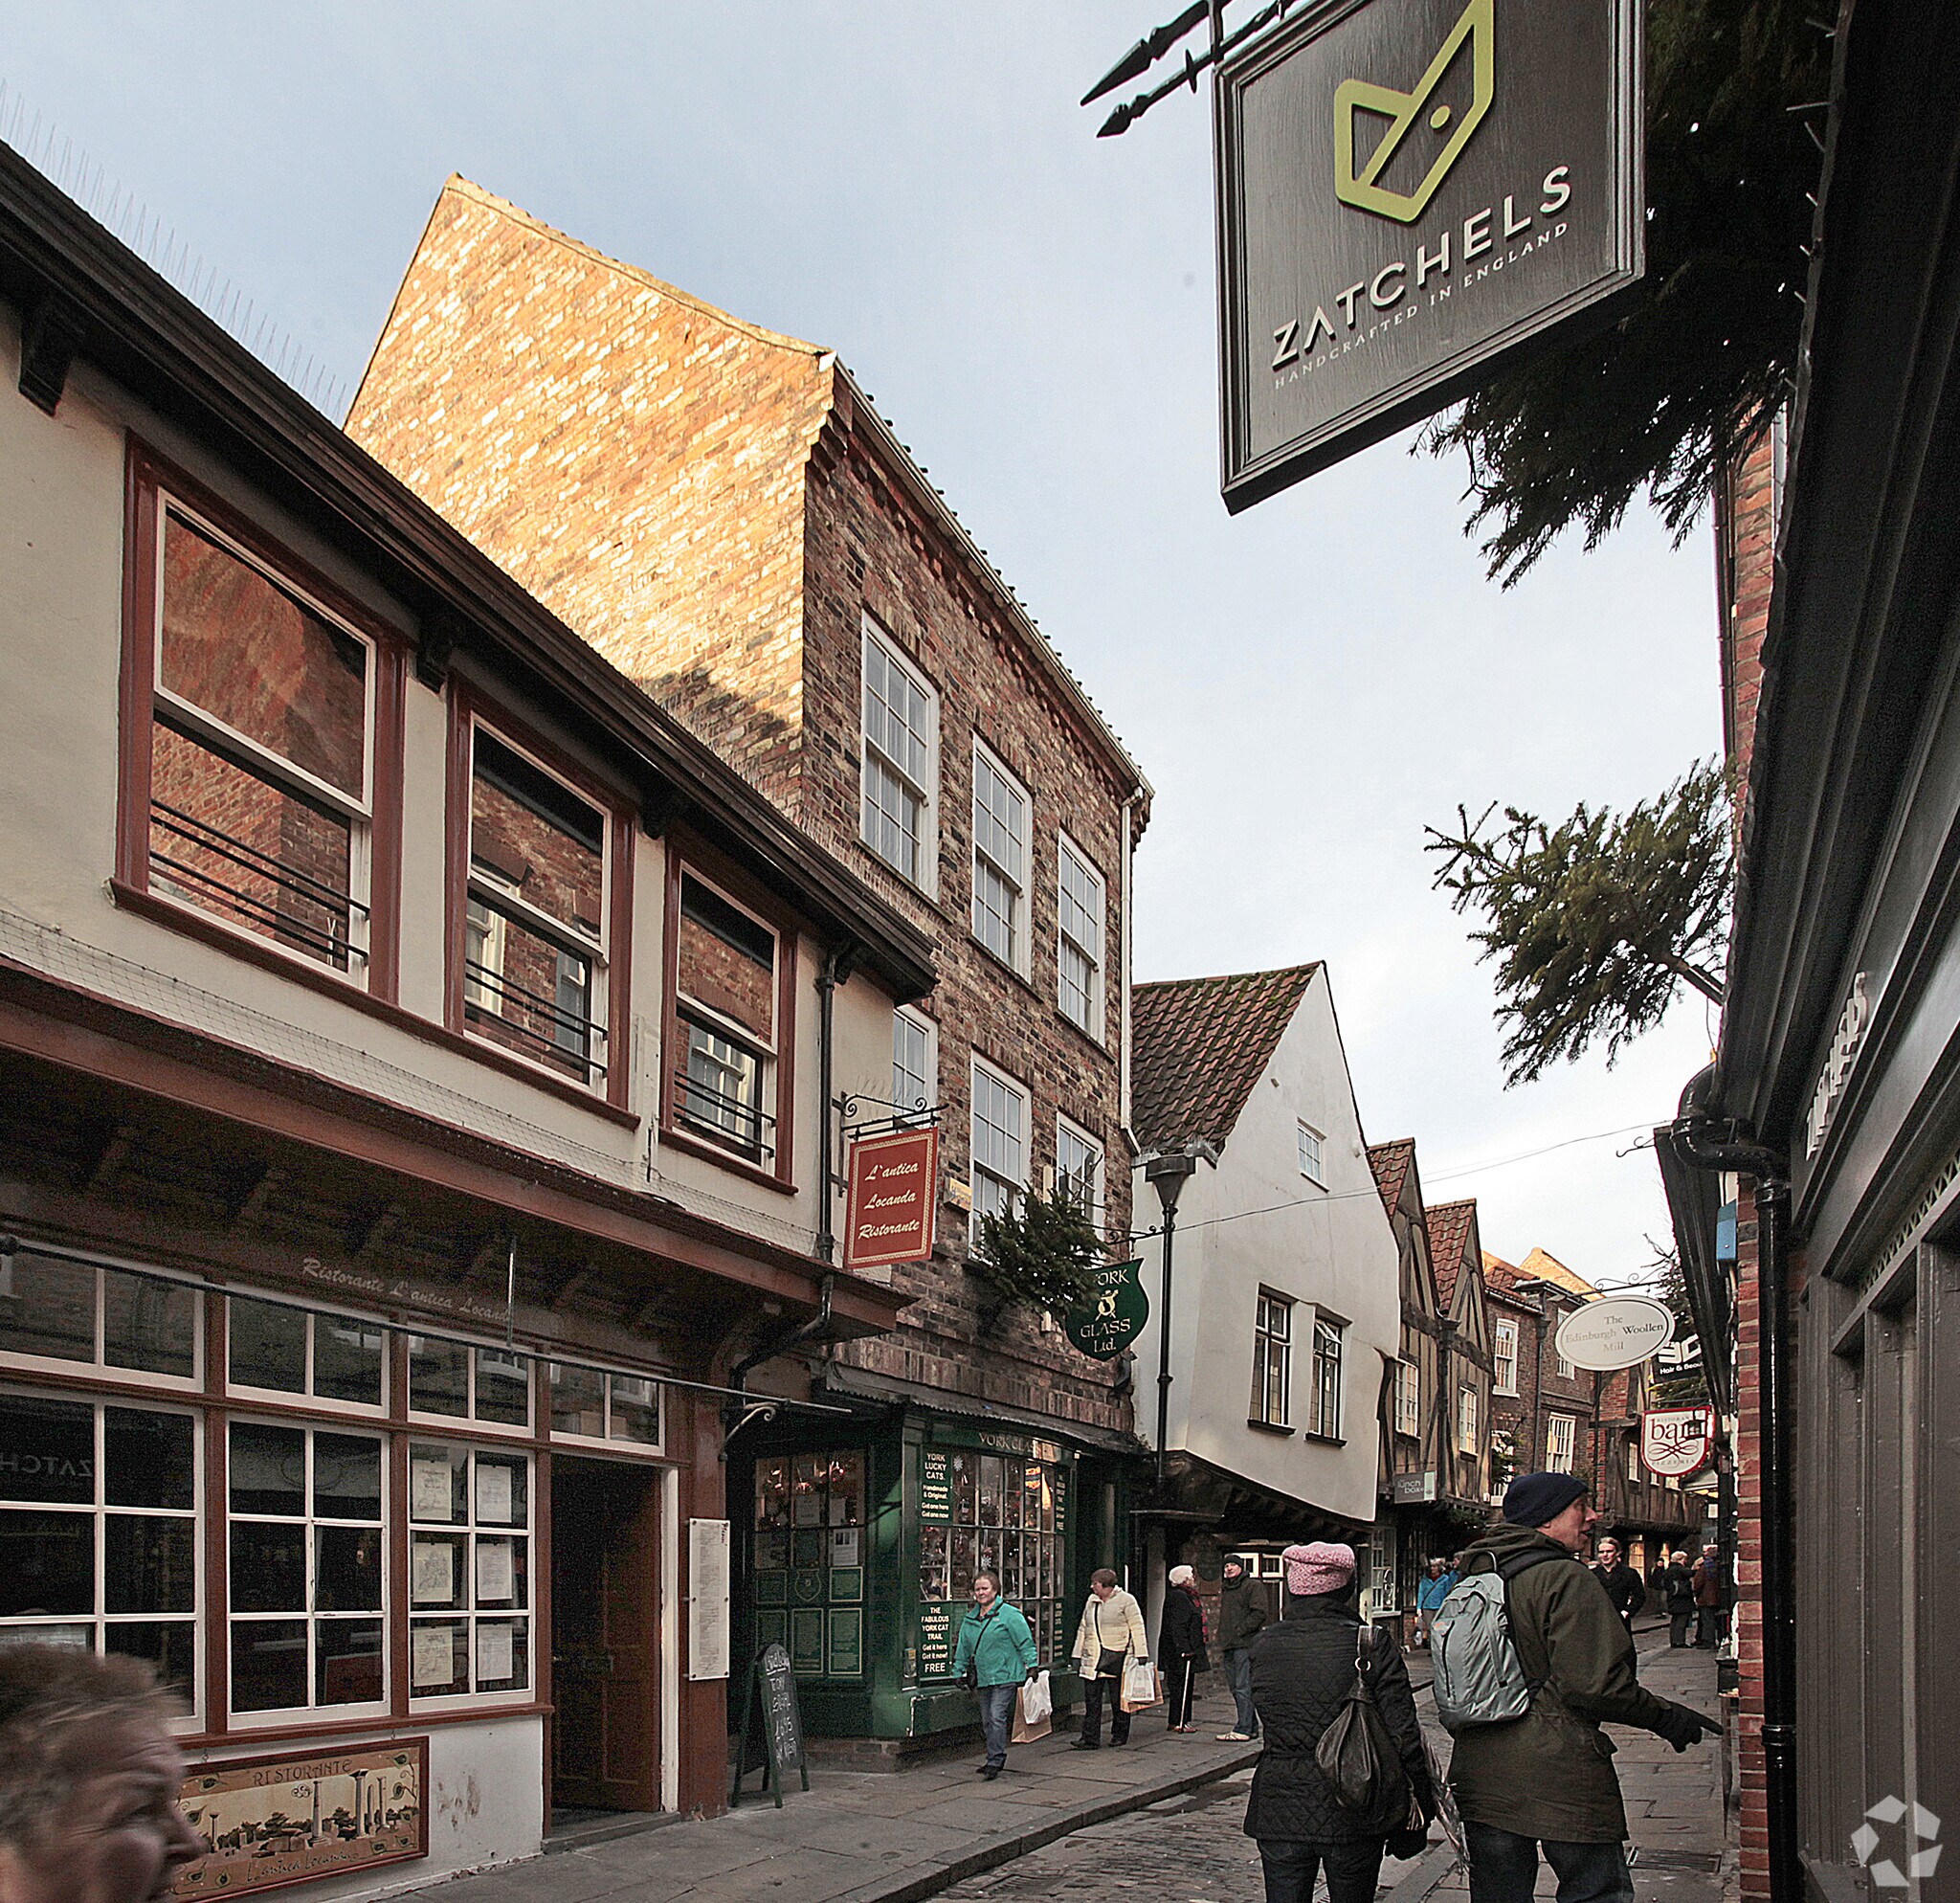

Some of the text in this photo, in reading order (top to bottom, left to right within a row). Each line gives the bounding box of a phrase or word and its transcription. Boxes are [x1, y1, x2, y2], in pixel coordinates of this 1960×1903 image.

[1272, 166, 1571, 367] ZATCHELS
[1275, 222, 1568, 390] HANDCRAFTED IN ENGLAND
[864, 1189, 917, 1210] Locanda
[858, 1219, 920, 1240] Ristorante
[1095, 1268, 1130, 1287] ORK
[302, 1257, 384, 1292] Ristorante
[459, 1297, 513, 1321] Locand
[1080, 1318, 1130, 1338] GLASS
[1604, 1315, 1623, 1325] The
[1566, 1323, 1664, 1343] Edinburgh Woollen
[1094, 1337, 1117, 1353] Ltd.
[1603, 1342, 1624, 1353] Mill
[979, 1432, 1011, 1451] YORK
[924, 1462, 947, 1471] LUCKY
[927, 1453, 946, 1462] YORK
[924, 1663, 946, 1672] FREE
[253, 1759, 352, 1786] RISTORANTE
